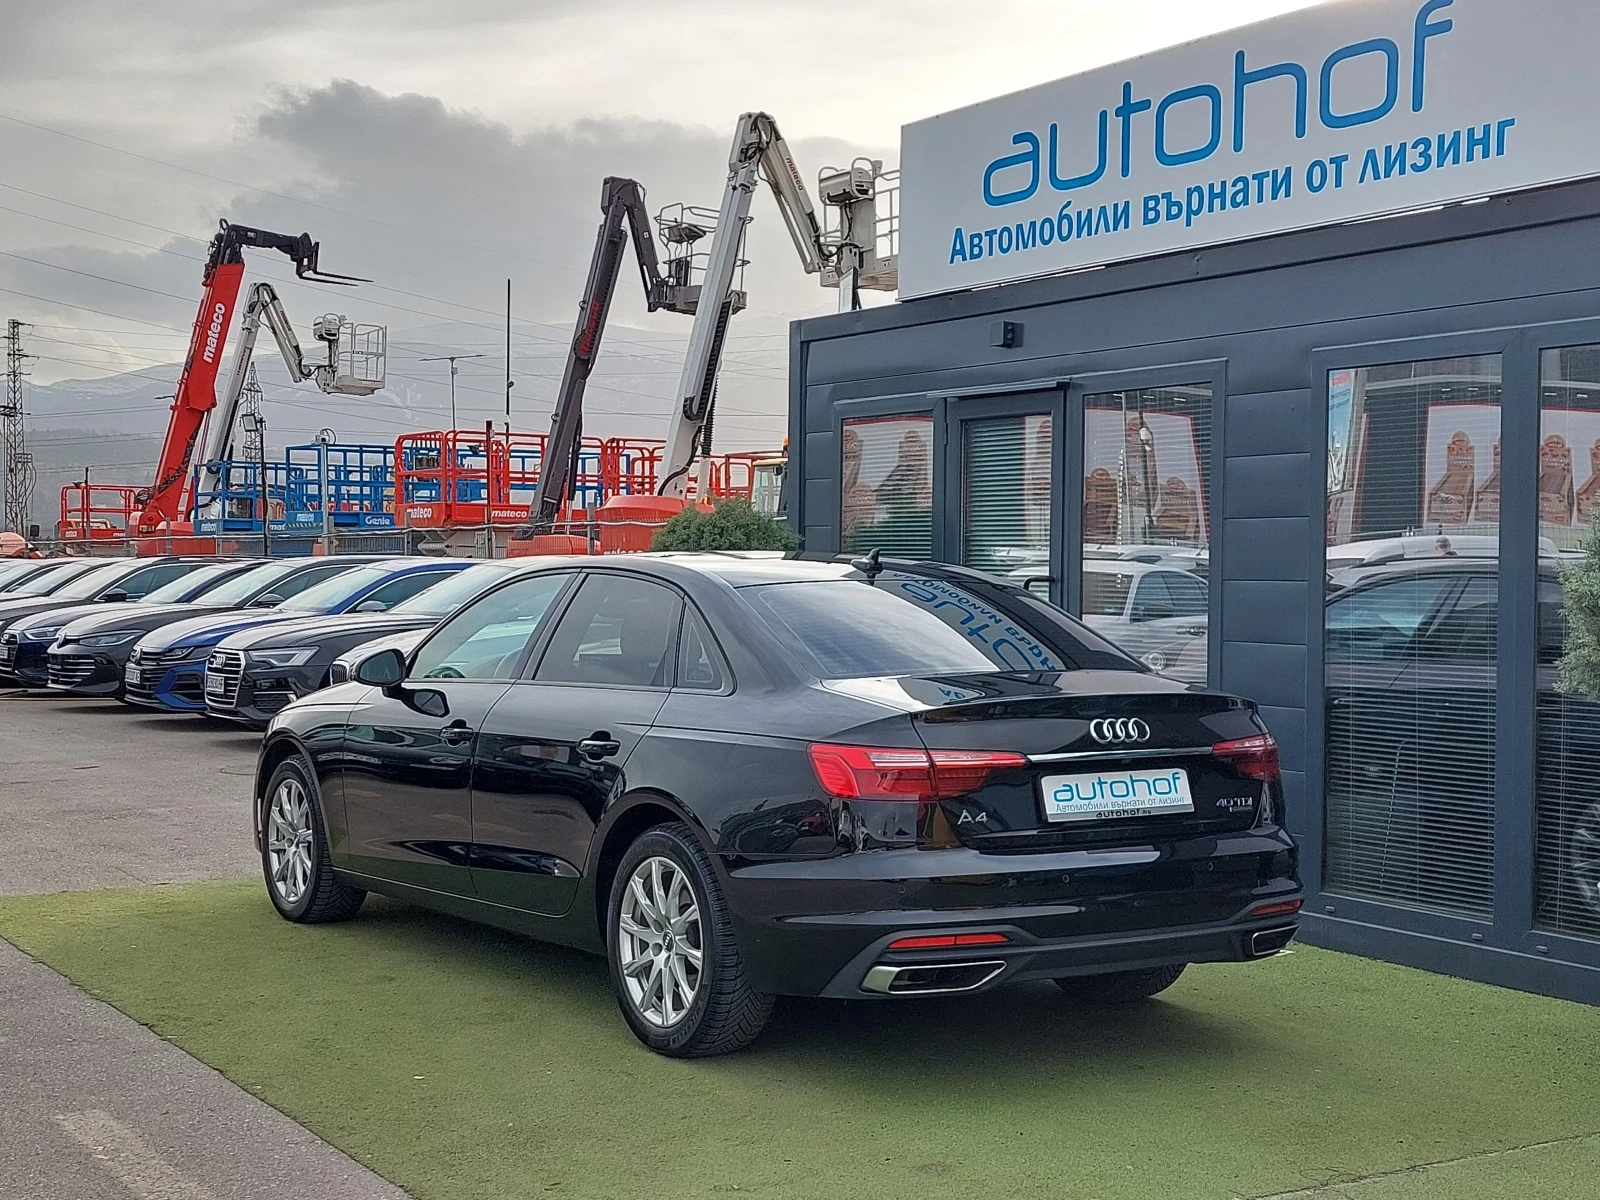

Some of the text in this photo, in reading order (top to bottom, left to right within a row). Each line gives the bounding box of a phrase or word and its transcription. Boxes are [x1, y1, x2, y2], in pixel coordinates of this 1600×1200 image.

[983, 0, 1453, 207] autohof
[786, 157, 803, 191] mateco
[949, 117, 1517, 265] Автомобили върнати от лизинг
[203, 303, 226, 364] mateco
[365, 516, 391, 526] Genie
[491, 509, 528, 518] mateco
[1053, 772, 1181, 803] autohof
[957, 809, 989, 825] A4
[1056, 796, 1186, 813] Автомобили върнати от лизинг
